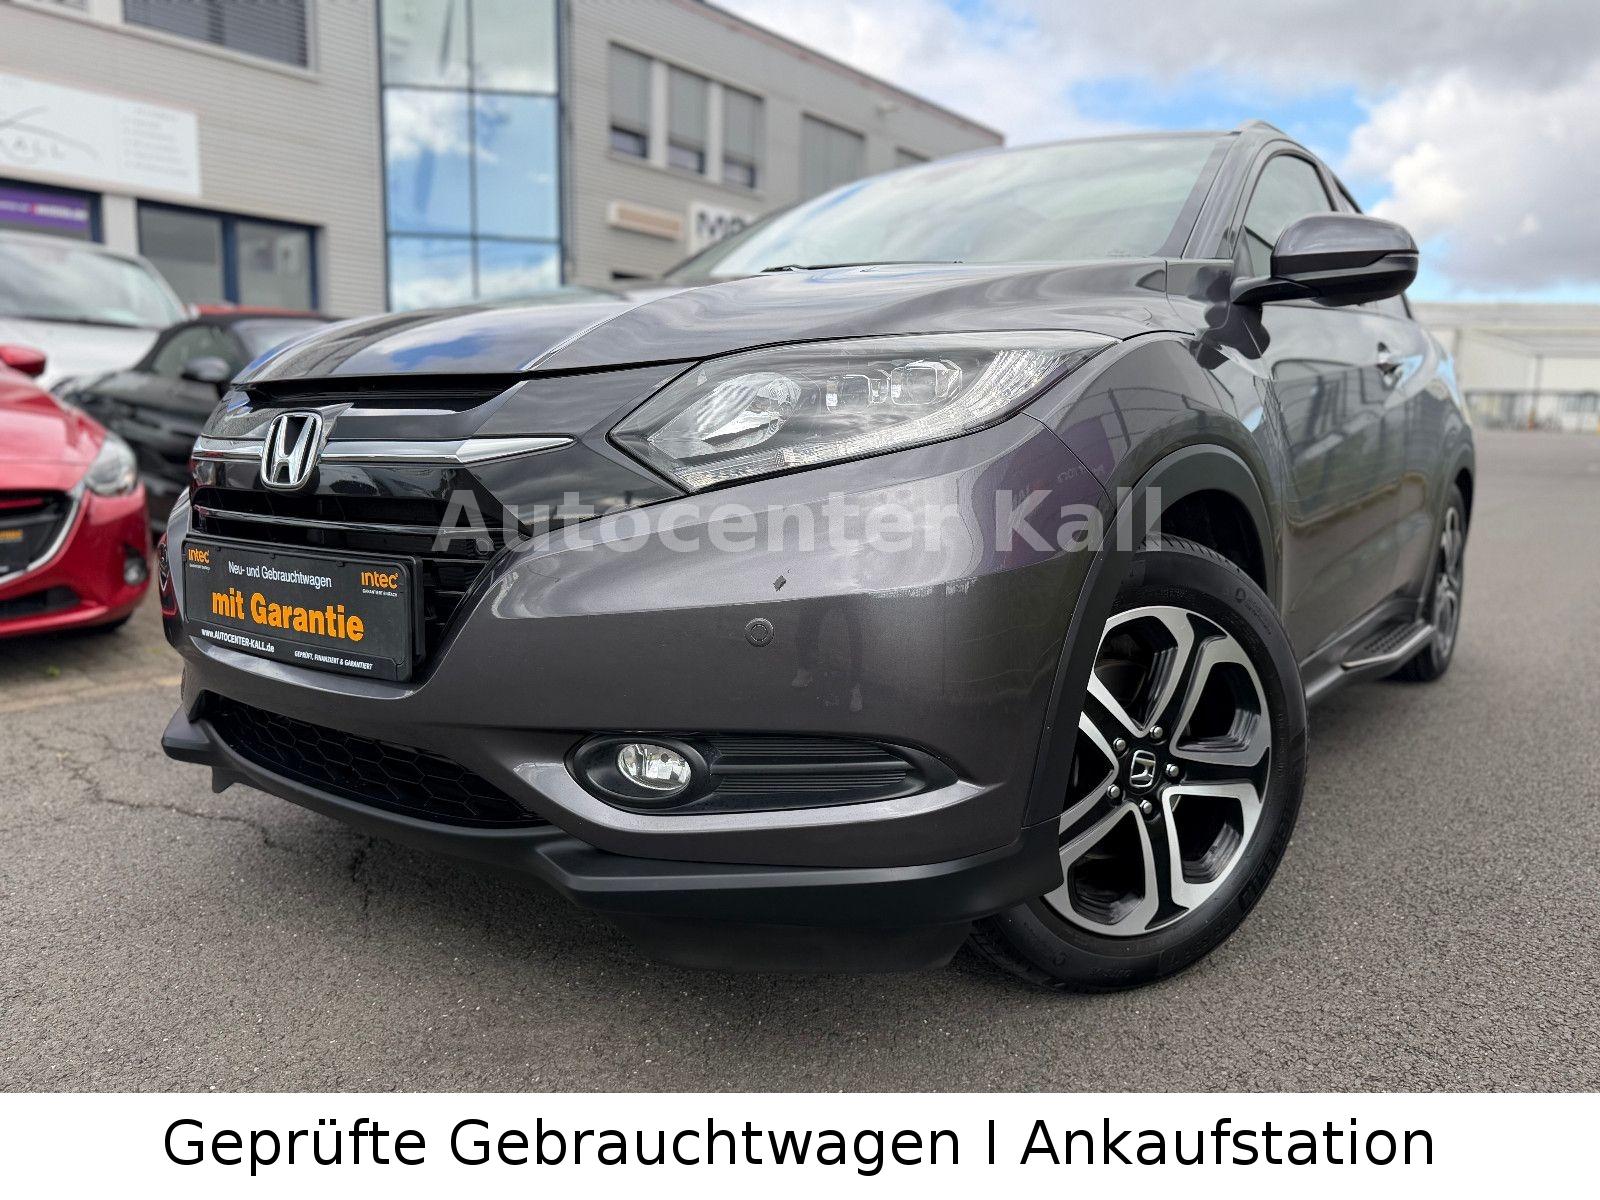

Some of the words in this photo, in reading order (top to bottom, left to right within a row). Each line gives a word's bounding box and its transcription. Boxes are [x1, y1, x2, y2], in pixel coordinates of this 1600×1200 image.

[188, 549, 210, 564] intec
[228, 561, 246, 576] Neu-
[246, 564, 260, 579] und
[261, 566, 332, 590] Gebrauchtwagen
[360, 571, 397, 589] intec
[212, 588, 245, 620] mit
[250, 592, 365, 642] Garantie
[201, 628, 275, 653] www.AUTOCENTER-KALL.de
